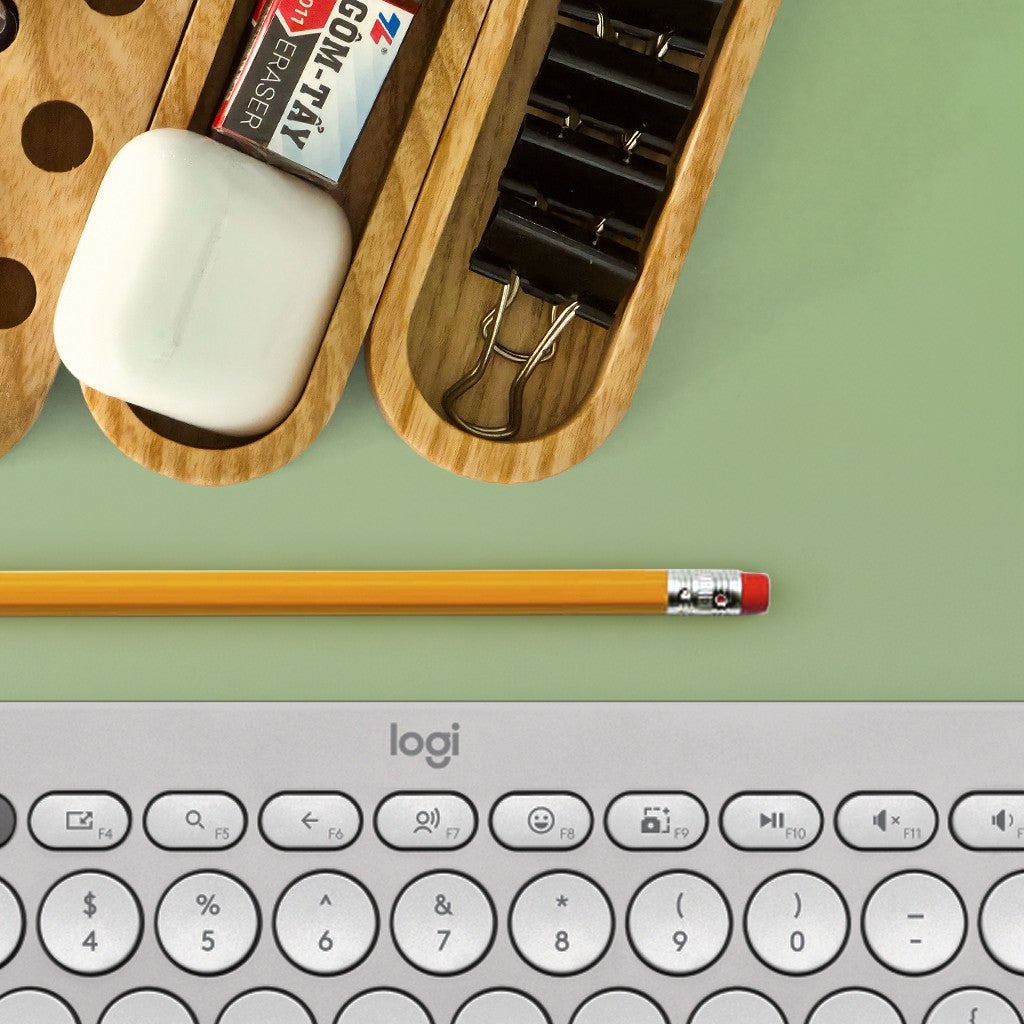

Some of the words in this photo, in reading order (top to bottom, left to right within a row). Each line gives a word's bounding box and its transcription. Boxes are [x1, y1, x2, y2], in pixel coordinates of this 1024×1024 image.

[240, 38, 297, 130] ERASER
[389, 722, 460, 770] logi
[98, 827, 114, 840] F4
[214, 827, 230, 840] F5
[327, 827, 345, 840] F6
[445, 827, 461, 840] F7
[559, 827, 576, 840] F8
[673, 827, 691, 840] F9
[785, 827, 807, 840] F10
[903, 827, 922, 840] F11
[82, 890, 97, 919] $
[195, 893, 221, 916] %
[433, 893, 454, 916] &
[676, 892, 684, 919] (
[793, 892, 802, 919] )
[81, 929, 99, 952] 4
[201, 929, 215, 952] 5
[318, 929, 334, 952] 6
[436, 929, 452, 952] 7
[554, 930, 570, 953] 8
[672, 930, 688, 952] 9
[789, 930, 806, 953] 0
